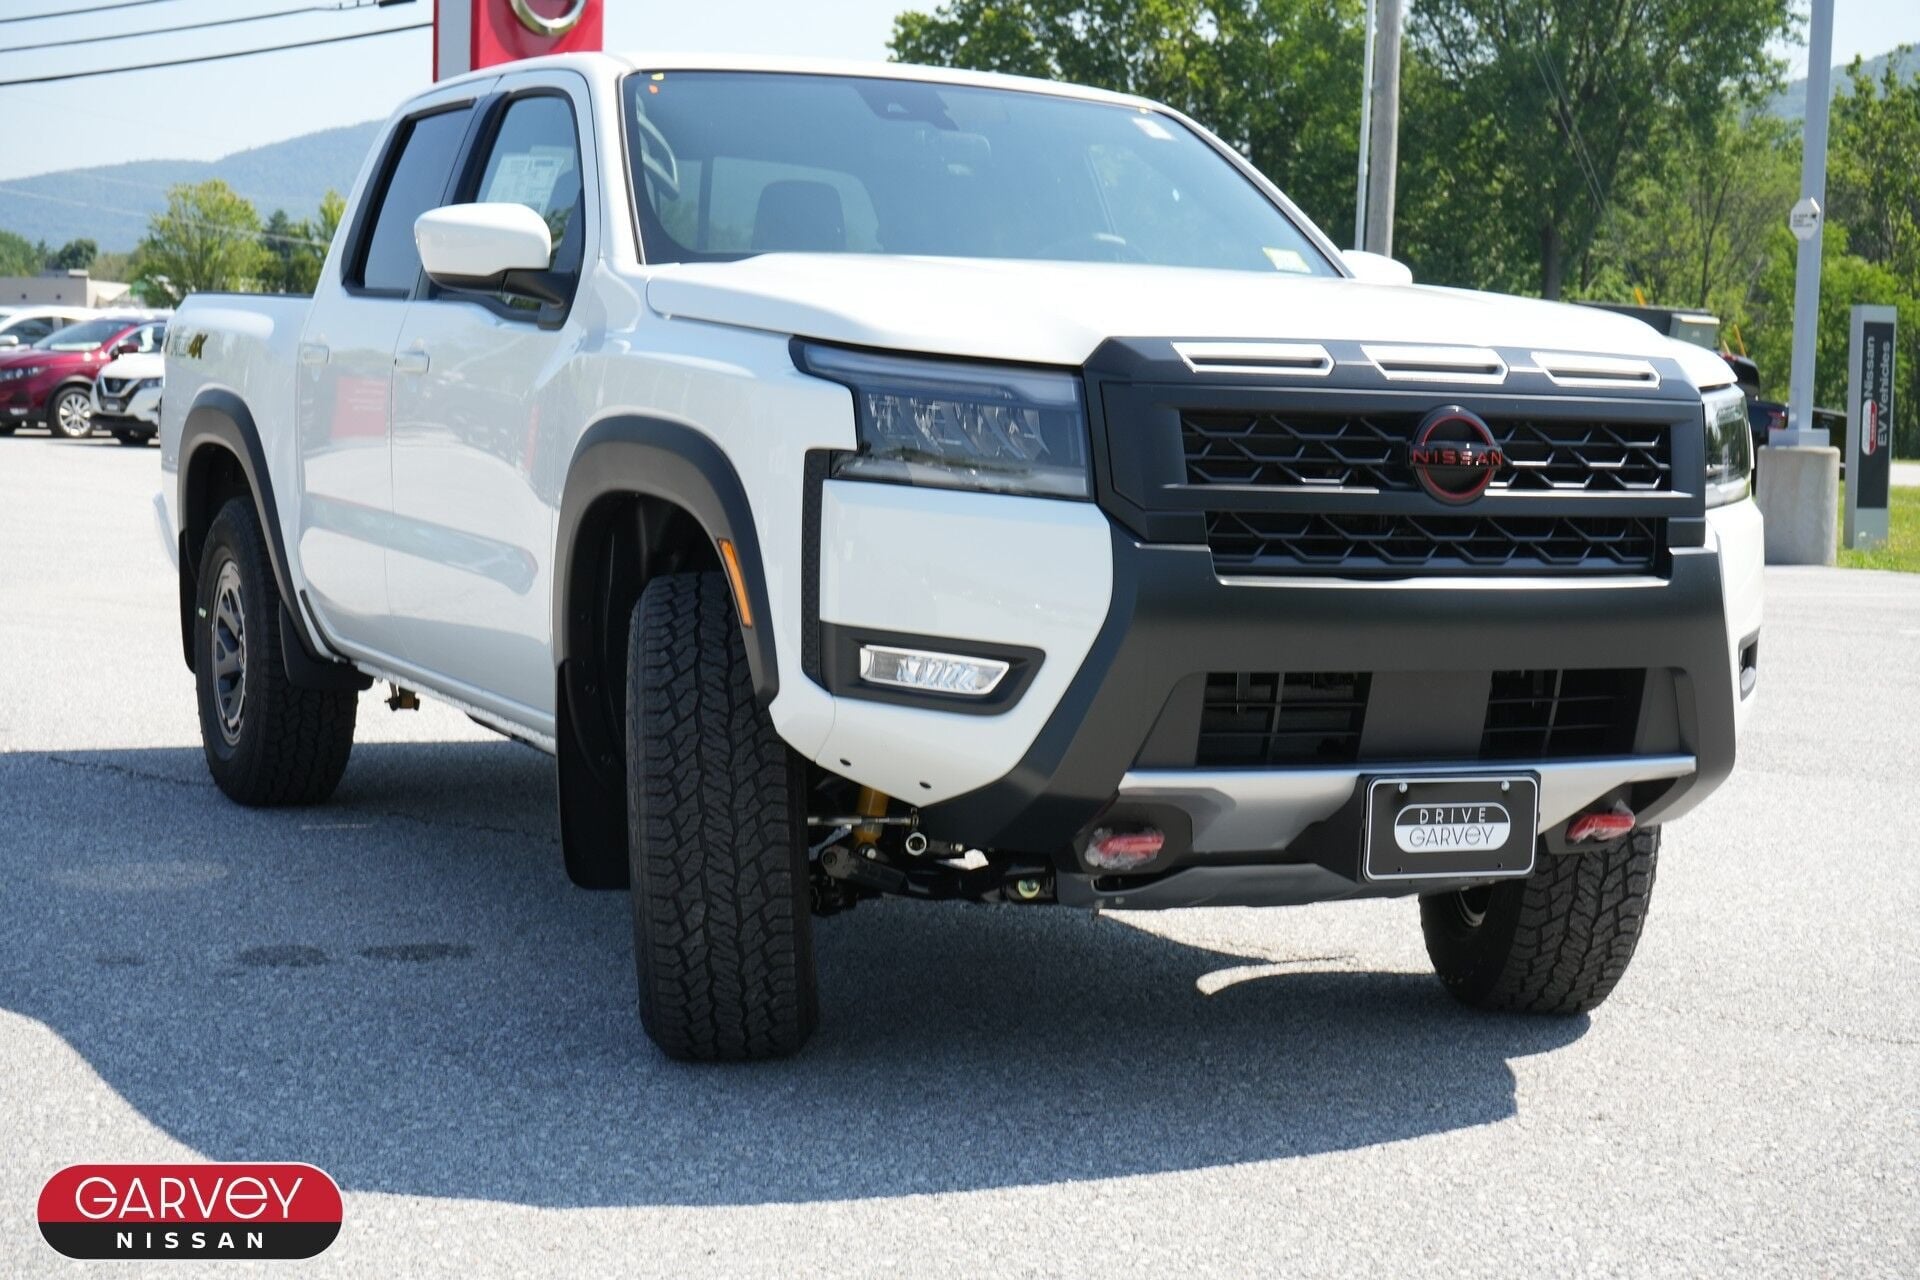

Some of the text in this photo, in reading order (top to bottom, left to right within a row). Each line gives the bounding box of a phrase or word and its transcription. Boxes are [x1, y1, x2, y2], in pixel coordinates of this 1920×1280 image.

[1864, 335, 1875, 398] Nissan
[1877, 341, 1890, 446] EV Vehicles
[1412, 449, 1503, 465] NISSAN
[1419, 807, 1487, 825] DRIVE
[1409, 825, 1495, 848] GARVEY
